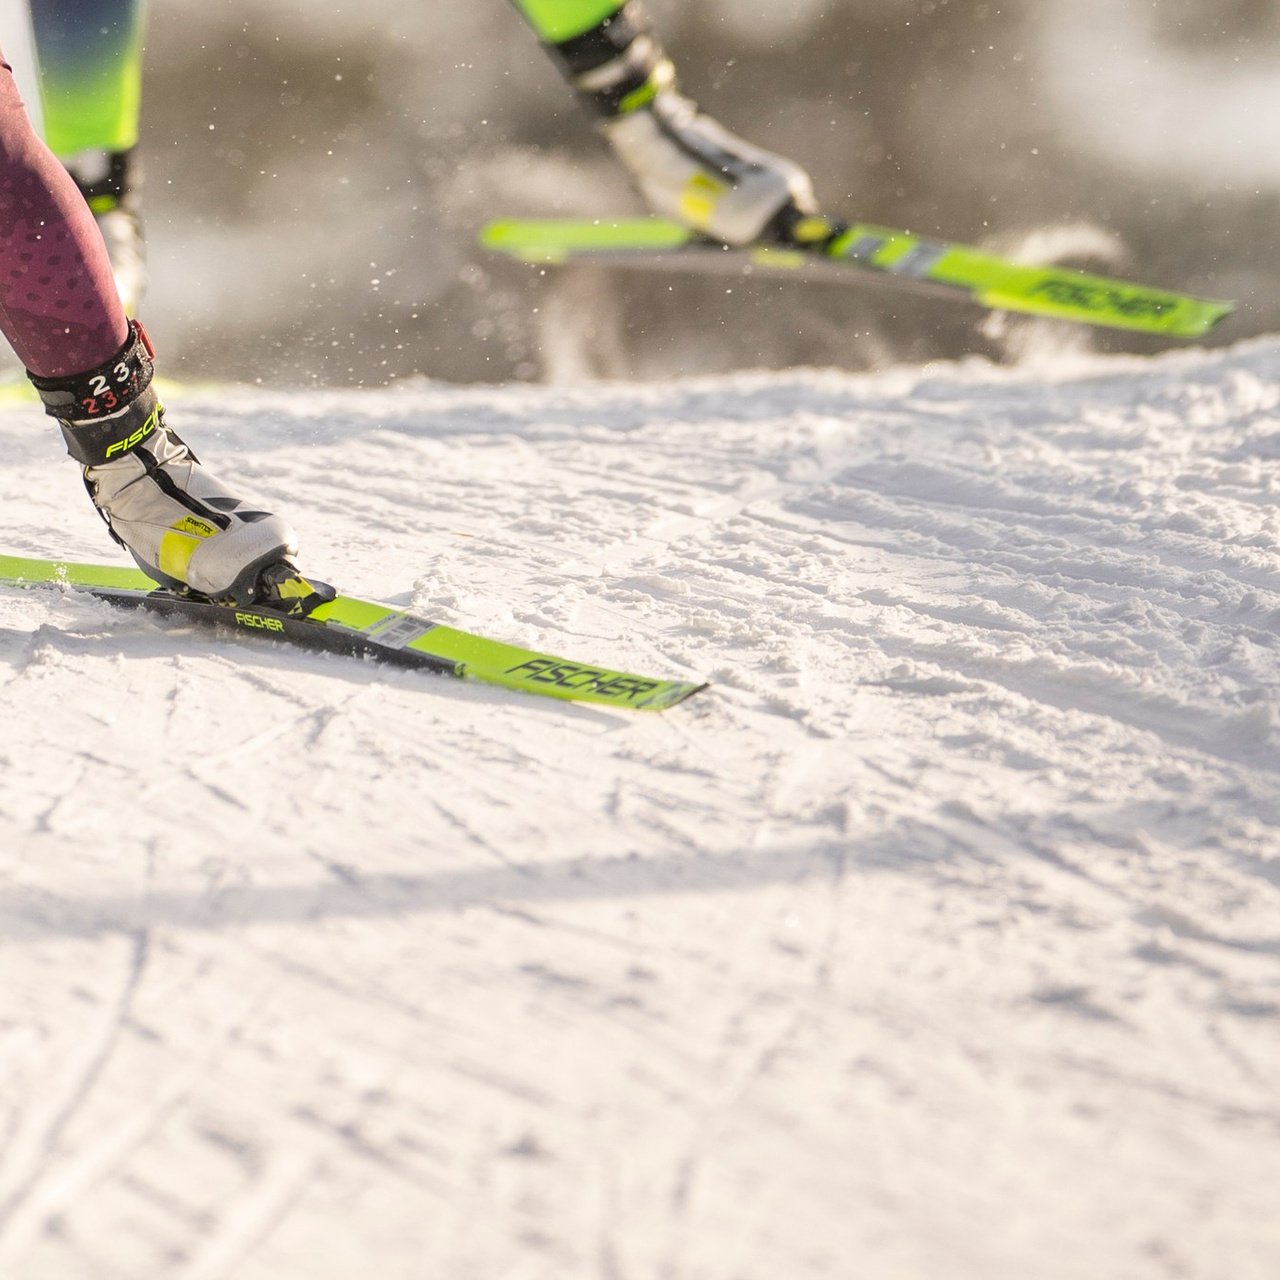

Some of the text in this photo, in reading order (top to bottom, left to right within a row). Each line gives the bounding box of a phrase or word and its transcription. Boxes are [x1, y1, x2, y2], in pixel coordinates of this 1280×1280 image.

[88, 361, 130, 397] 23
[235, 612, 285, 633] FISCHER
[505, 658, 659, 701] FISCHER
